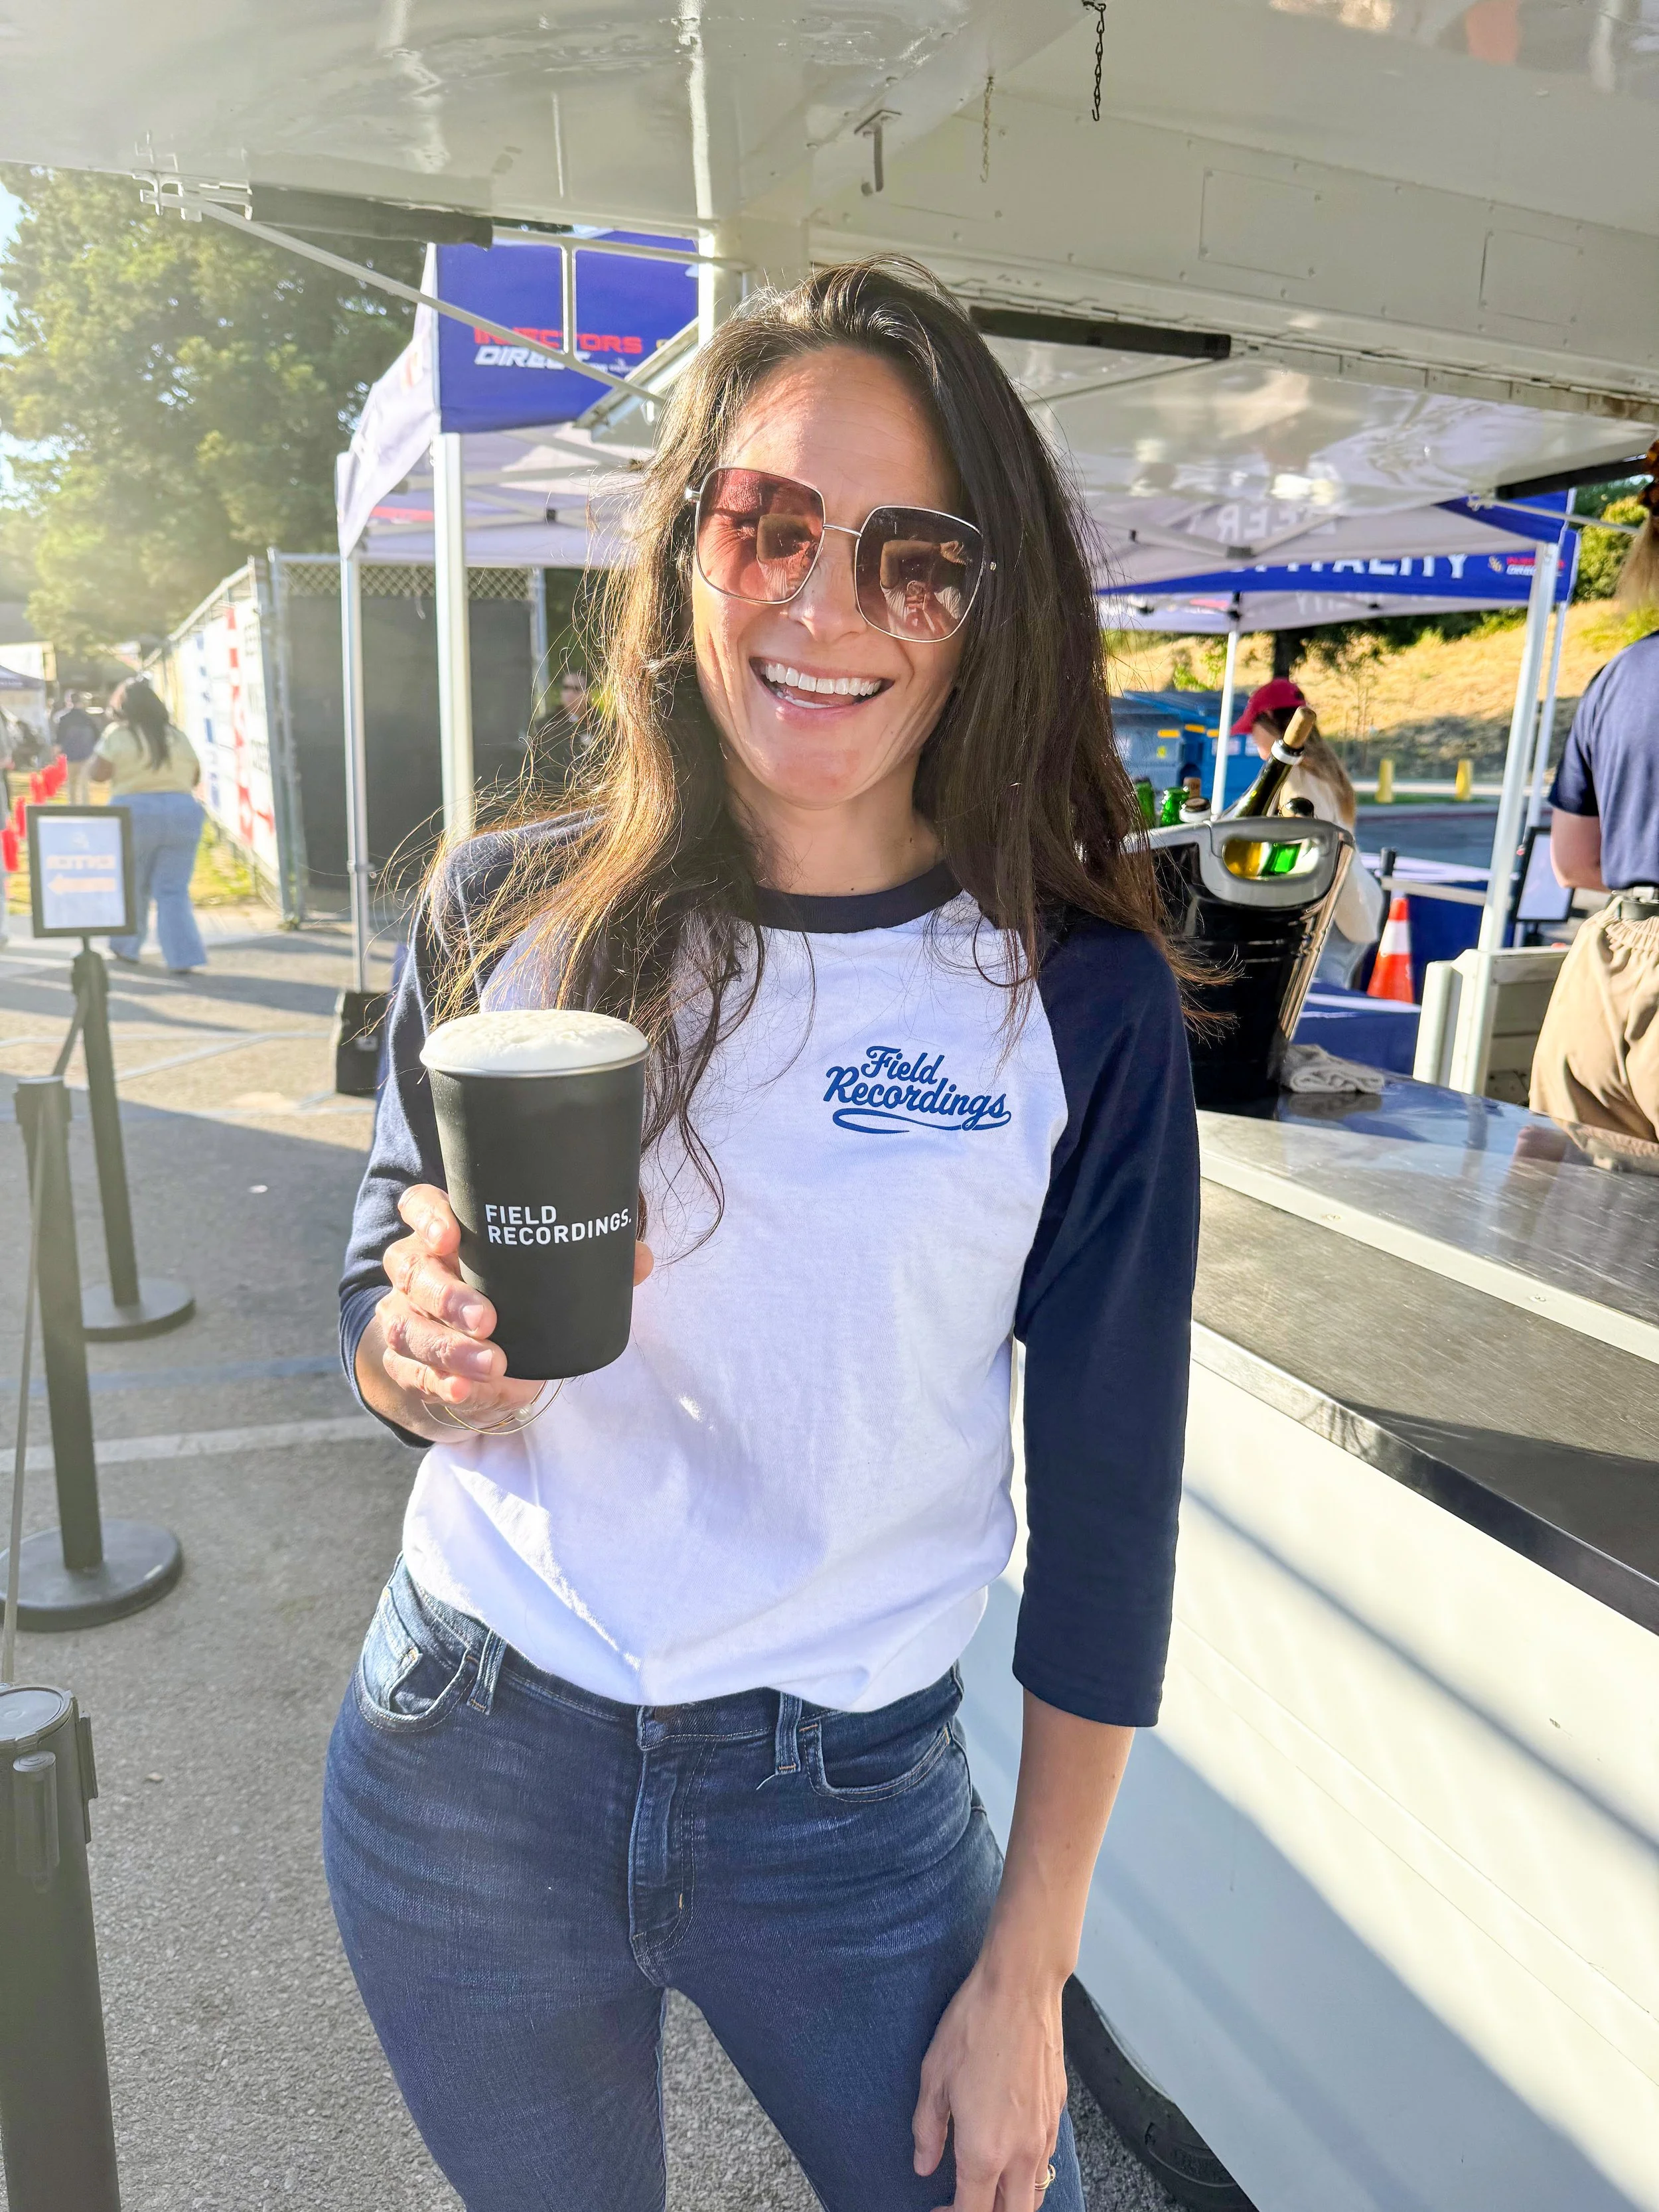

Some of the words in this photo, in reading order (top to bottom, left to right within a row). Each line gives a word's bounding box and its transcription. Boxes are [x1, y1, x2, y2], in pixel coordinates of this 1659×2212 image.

[861, 1045, 945, 1084] Field
[823, 1066, 1012, 1132] Recordings
[485, 1204, 557, 1225] FIELD
[487, 1208, 632, 1246] RECORDINGS.
